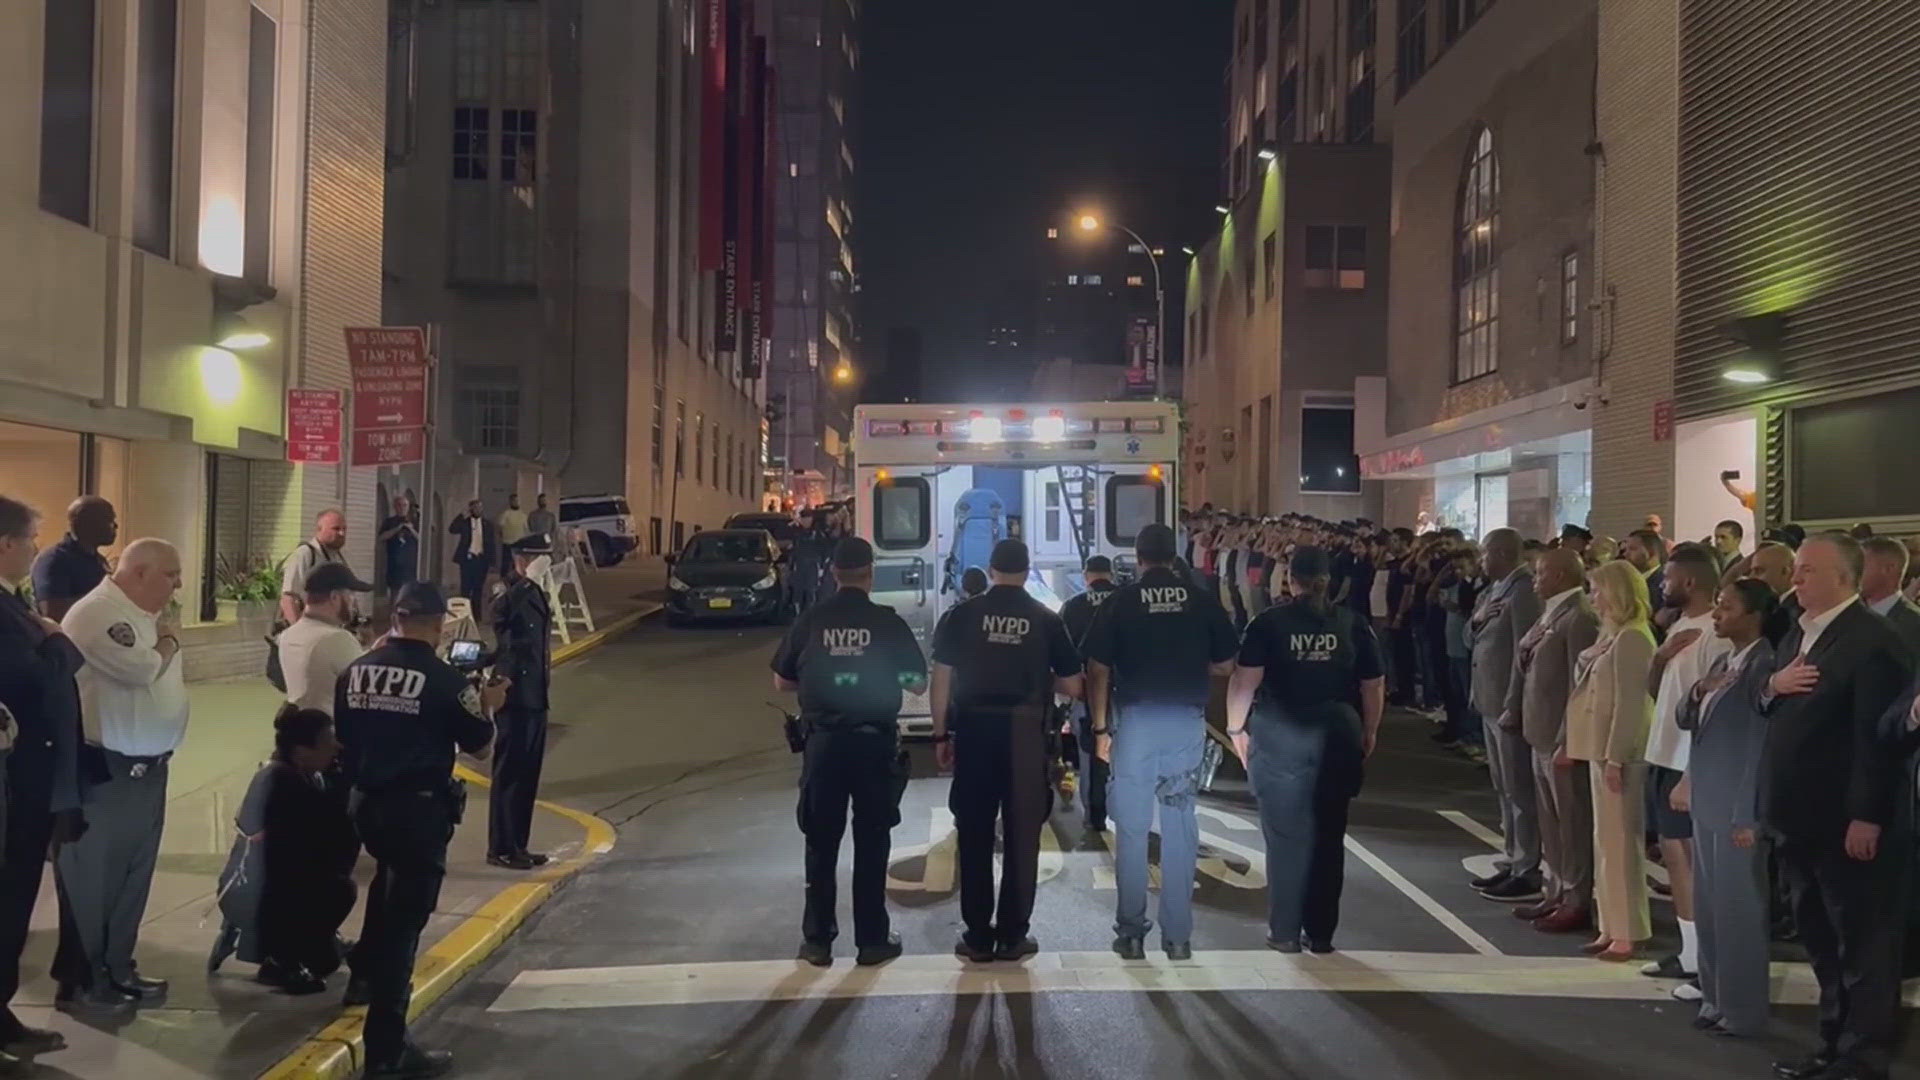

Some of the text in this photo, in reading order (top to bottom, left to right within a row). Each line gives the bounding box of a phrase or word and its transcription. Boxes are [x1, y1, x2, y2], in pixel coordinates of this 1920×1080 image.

[724, 240, 737, 337] STARR ENTRANCE
[352, 332, 416, 345] NO STANDING
[750, 315, 761, 366] ENTRANCE
[360, 349, 416, 363] 7AM-7PM
[378, 447, 401, 462] ZONE
[1086, 591, 1111, 602] NYP
[1140, 586, 1188, 603] NYPD
[982, 614, 1031, 635] NYPD
[822, 628, 871, 647] NYPD
[1290, 633, 1339, 651] NYPD
[347, 664, 427, 699] NYPD
